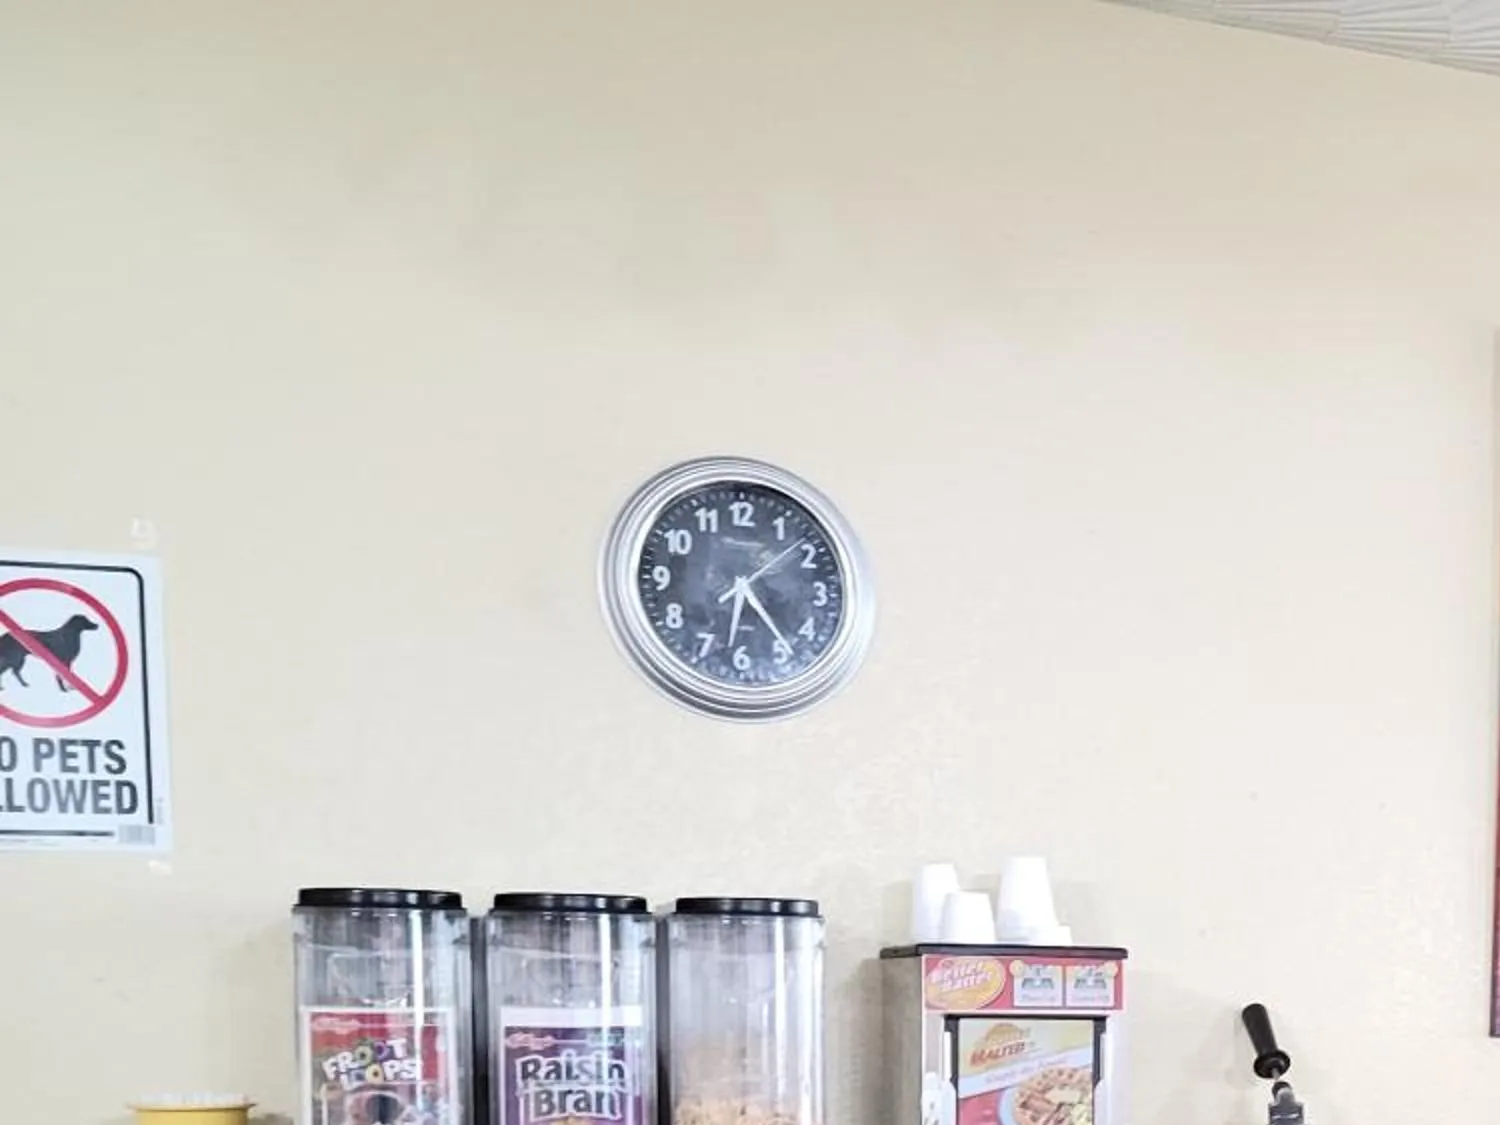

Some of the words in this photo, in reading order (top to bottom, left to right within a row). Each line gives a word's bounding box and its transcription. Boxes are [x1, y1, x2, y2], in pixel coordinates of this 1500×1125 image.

[695, 508, 719, 533] 11
[729, 502, 755, 527] 12
[773, 517, 785, 541] 1
[664, 529, 692, 555] 10
[801, 544, 817, 569] 2
[653, 566, 671, 591] 9
[812, 582, 828, 607] 3
[666, 603, 684, 629] 8
[799, 617, 816, 641] 4
[696, 633, 715, 658] 7
[773, 640, 789, 665] 5
[733, 646, 751, 671] 6
[33, 738, 127, 775] PETS
[0, 777, 138, 815] LOWED
[521, 1051, 626, 1083] Raisin
[533, 1088, 617, 1117] Bran
